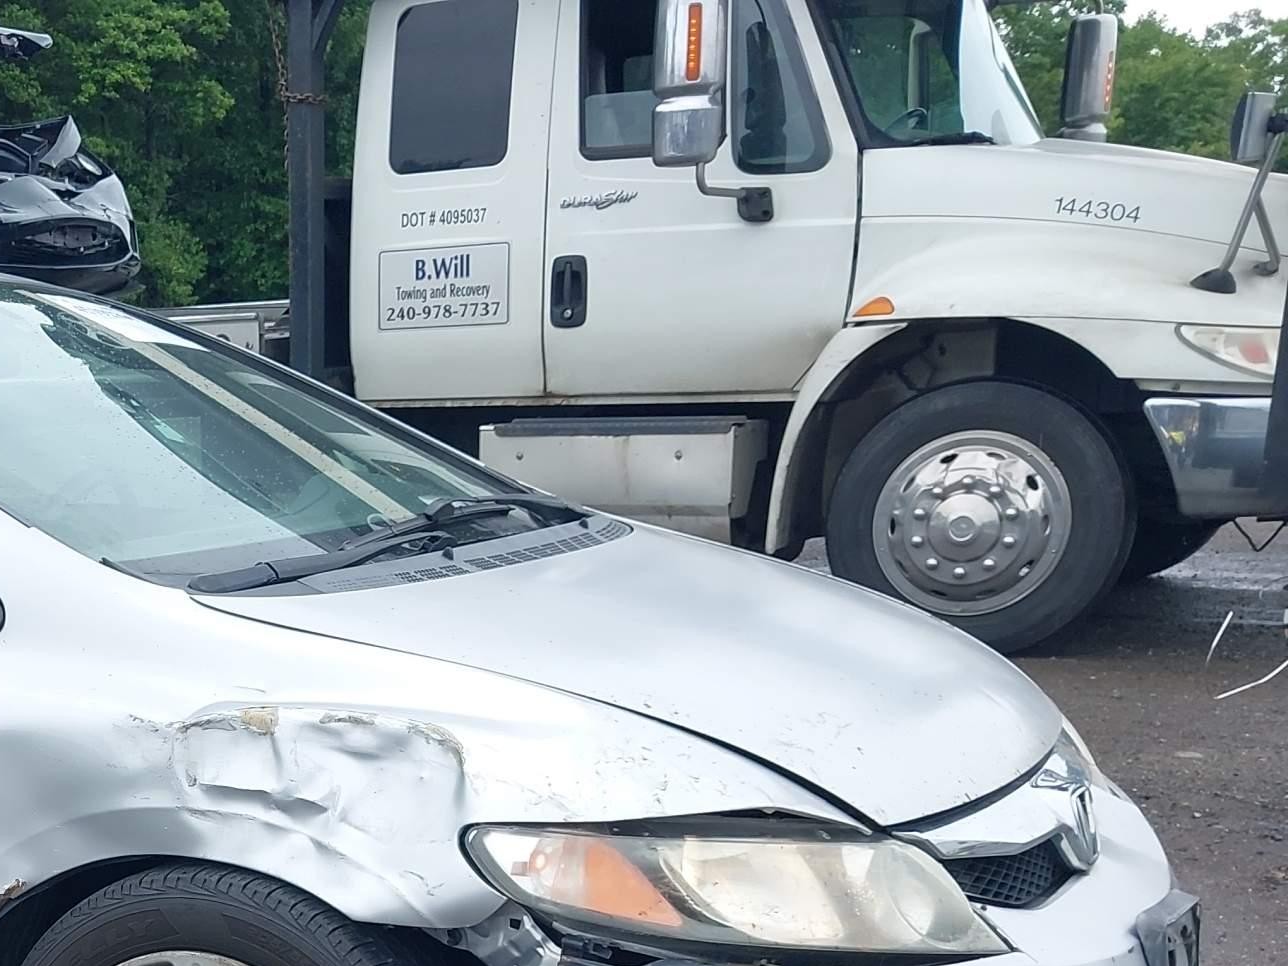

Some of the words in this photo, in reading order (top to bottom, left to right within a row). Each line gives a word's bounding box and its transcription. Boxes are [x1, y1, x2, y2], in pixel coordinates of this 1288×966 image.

[401, 212, 425, 228] DOT
[428, 210, 436, 226] #
[438, 207, 487, 225] 4095037
[1054, 197, 1141, 223] 144304
[415, 254, 470, 281] B.Will
[396, 284, 427, 303] Towing
[429, 283, 447, 299] and
[449, 283, 491, 300] Recovery
[385, 301, 501, 322] 240-978-7737
